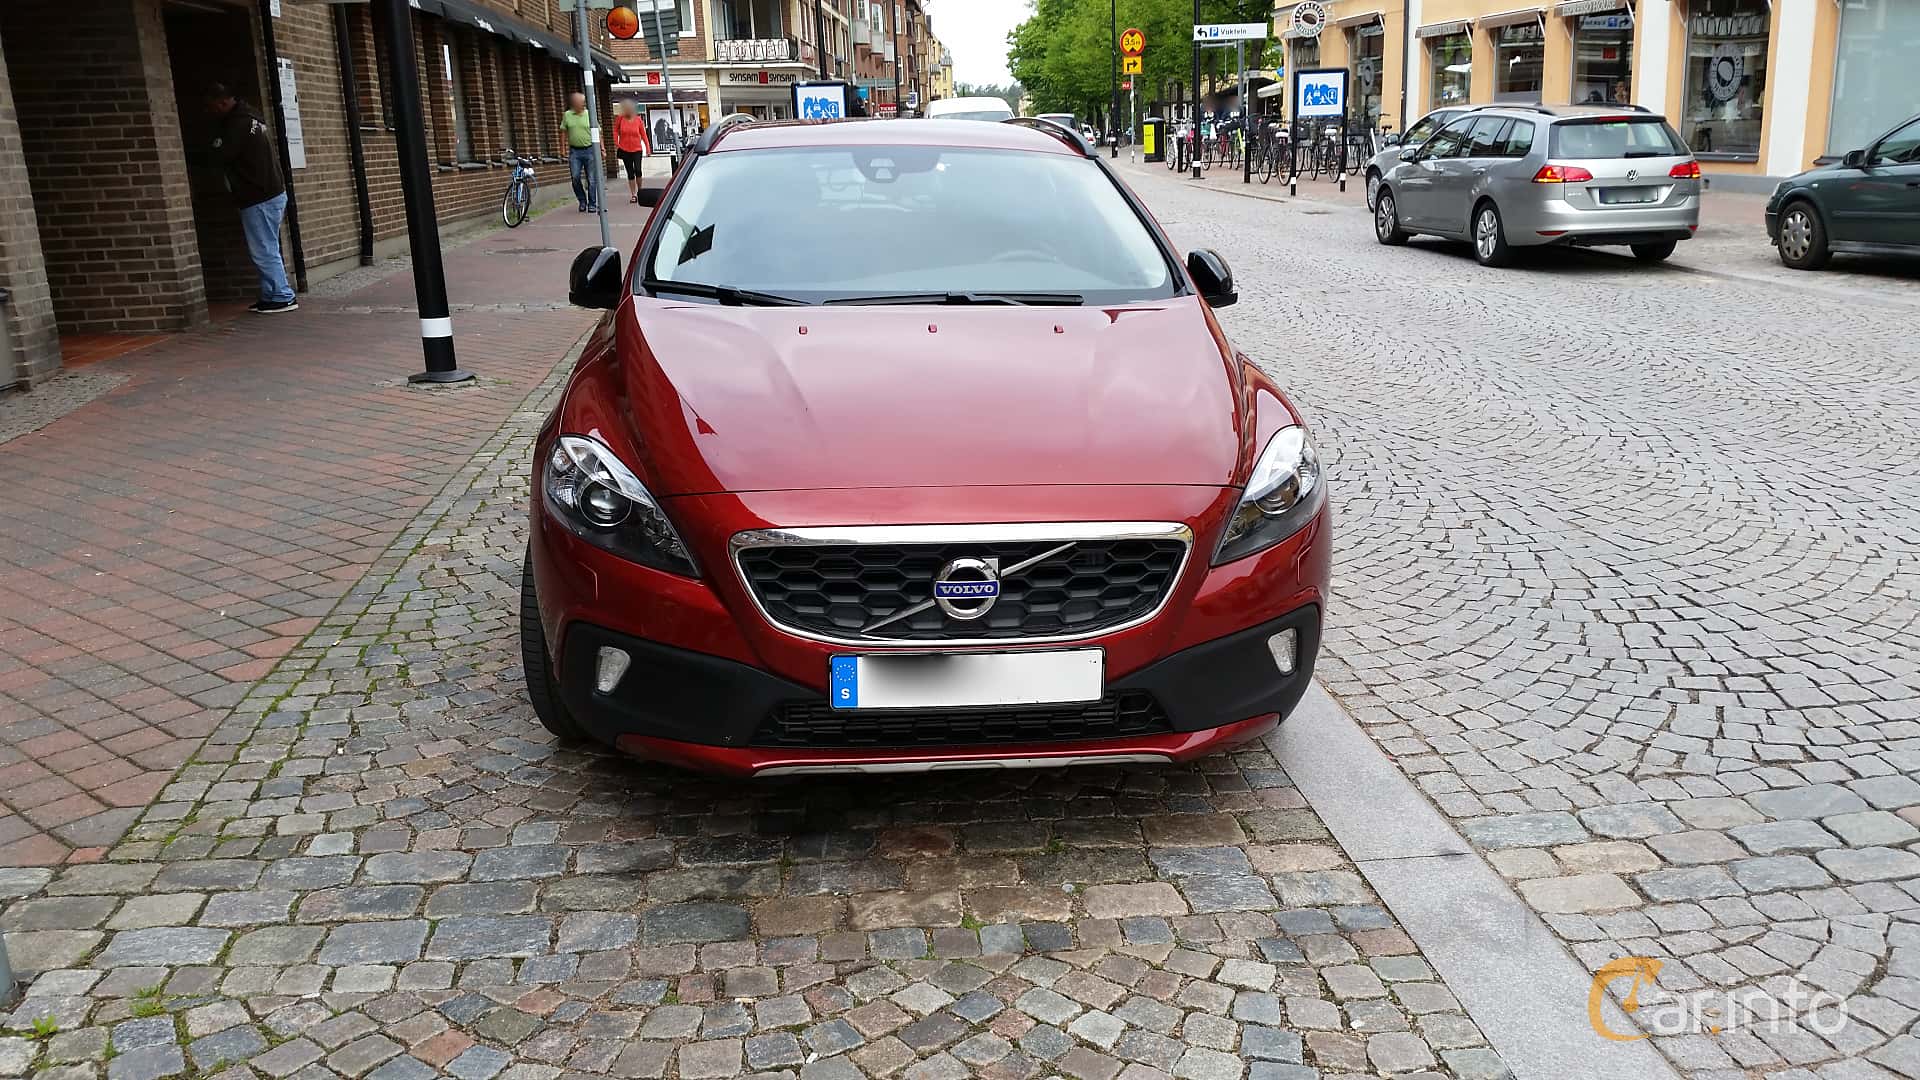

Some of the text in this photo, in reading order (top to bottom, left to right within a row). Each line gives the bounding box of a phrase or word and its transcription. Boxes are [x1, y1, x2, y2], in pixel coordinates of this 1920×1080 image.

[729, 73, 797, 82] SYNSAM SYNSAM
[939, 584, 995, 595] VOLVO
[840, 688, 850, 699] S
